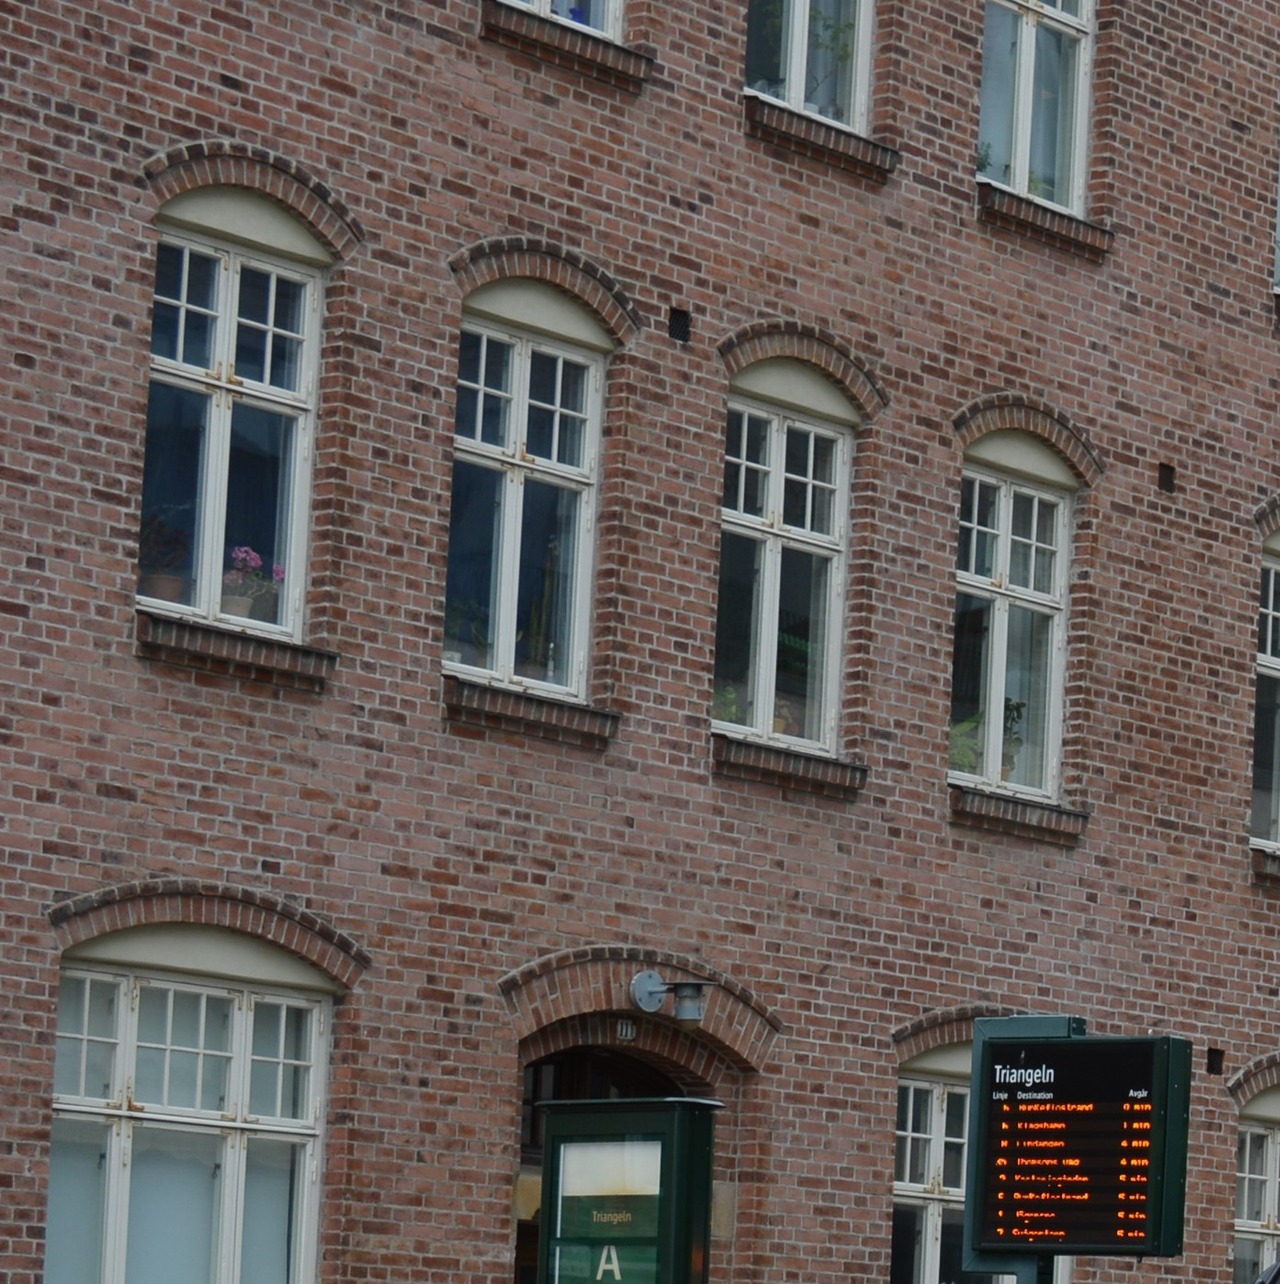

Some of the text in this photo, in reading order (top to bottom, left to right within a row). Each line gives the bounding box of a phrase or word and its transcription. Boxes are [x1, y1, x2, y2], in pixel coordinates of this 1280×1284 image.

[994, 1064, 1055, 1087] Triangeln
[993, 1091, 1009, 1101] Linje
[1017, 1091, 1054, 1100] Destination
[592, 1210, 632, 1225] Triangeln
[595, 1245, 622, 1281] A
